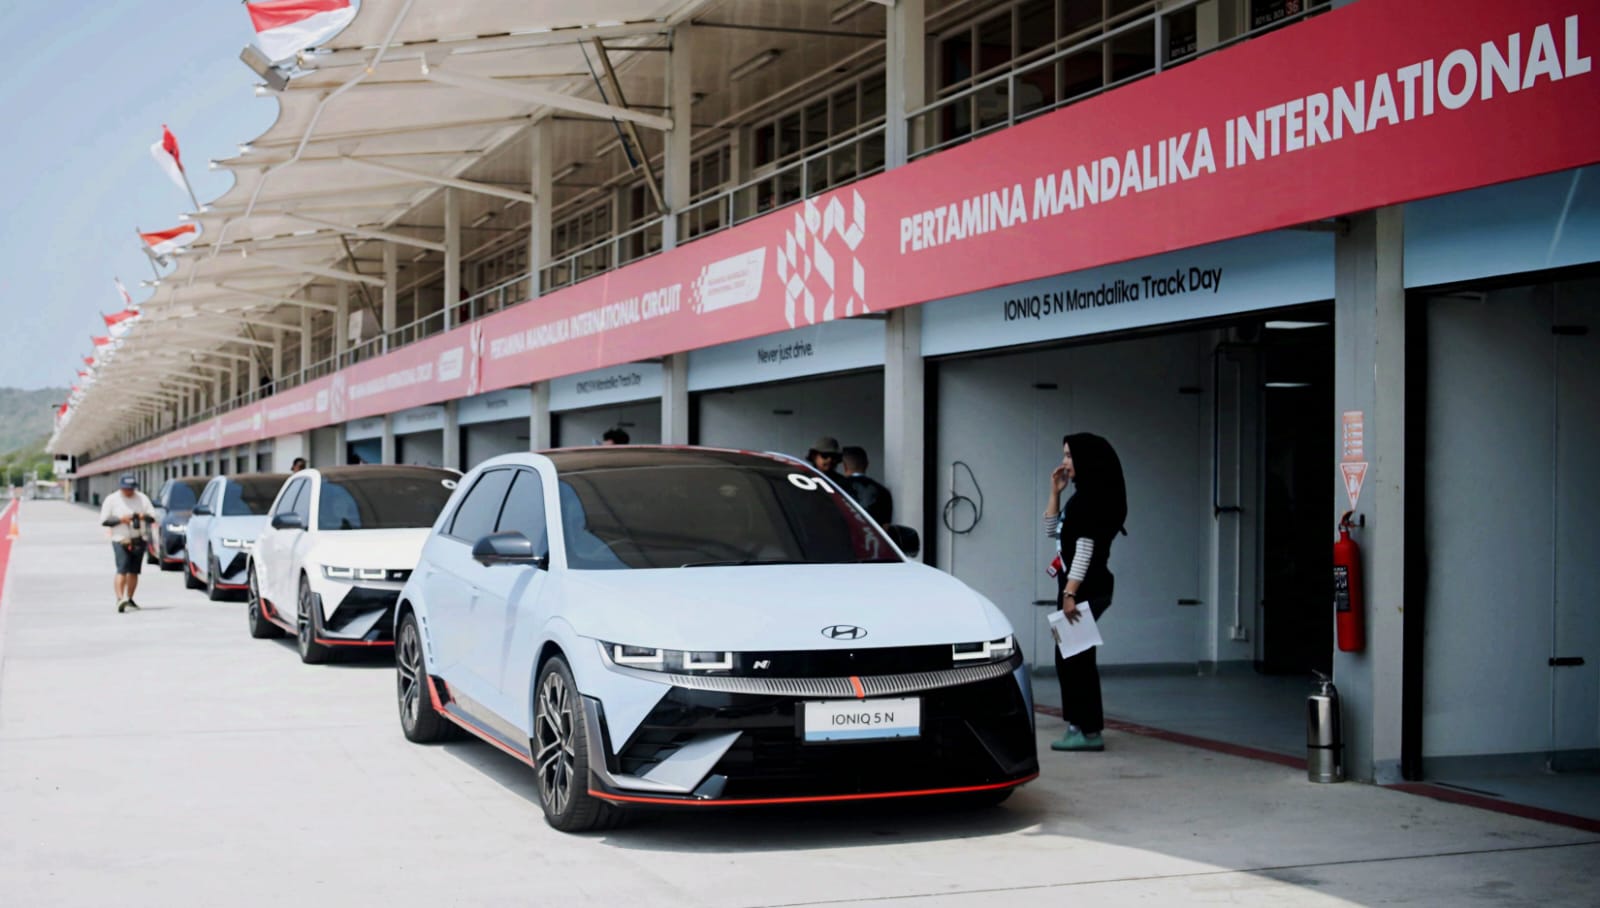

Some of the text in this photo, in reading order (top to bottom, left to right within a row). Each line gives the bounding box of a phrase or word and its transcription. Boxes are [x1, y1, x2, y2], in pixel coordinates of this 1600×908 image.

[900, 15, 1592, 254] PERTAMINA MANDALIKA INTERNATIONAL
[570, 296, 641, 339] INTERNATIONAL
[642, 283, 682, 320] CIRCUIT
[1003, 266, 1222, 321] IONIQ 5 N Mandalika Track Day
[757, 347, 778, 364] Never
[779, 343, 792, 364] just
[787, 473, 835, 494] 01
[831, 712, 894, 727] IONIQ 5 N
